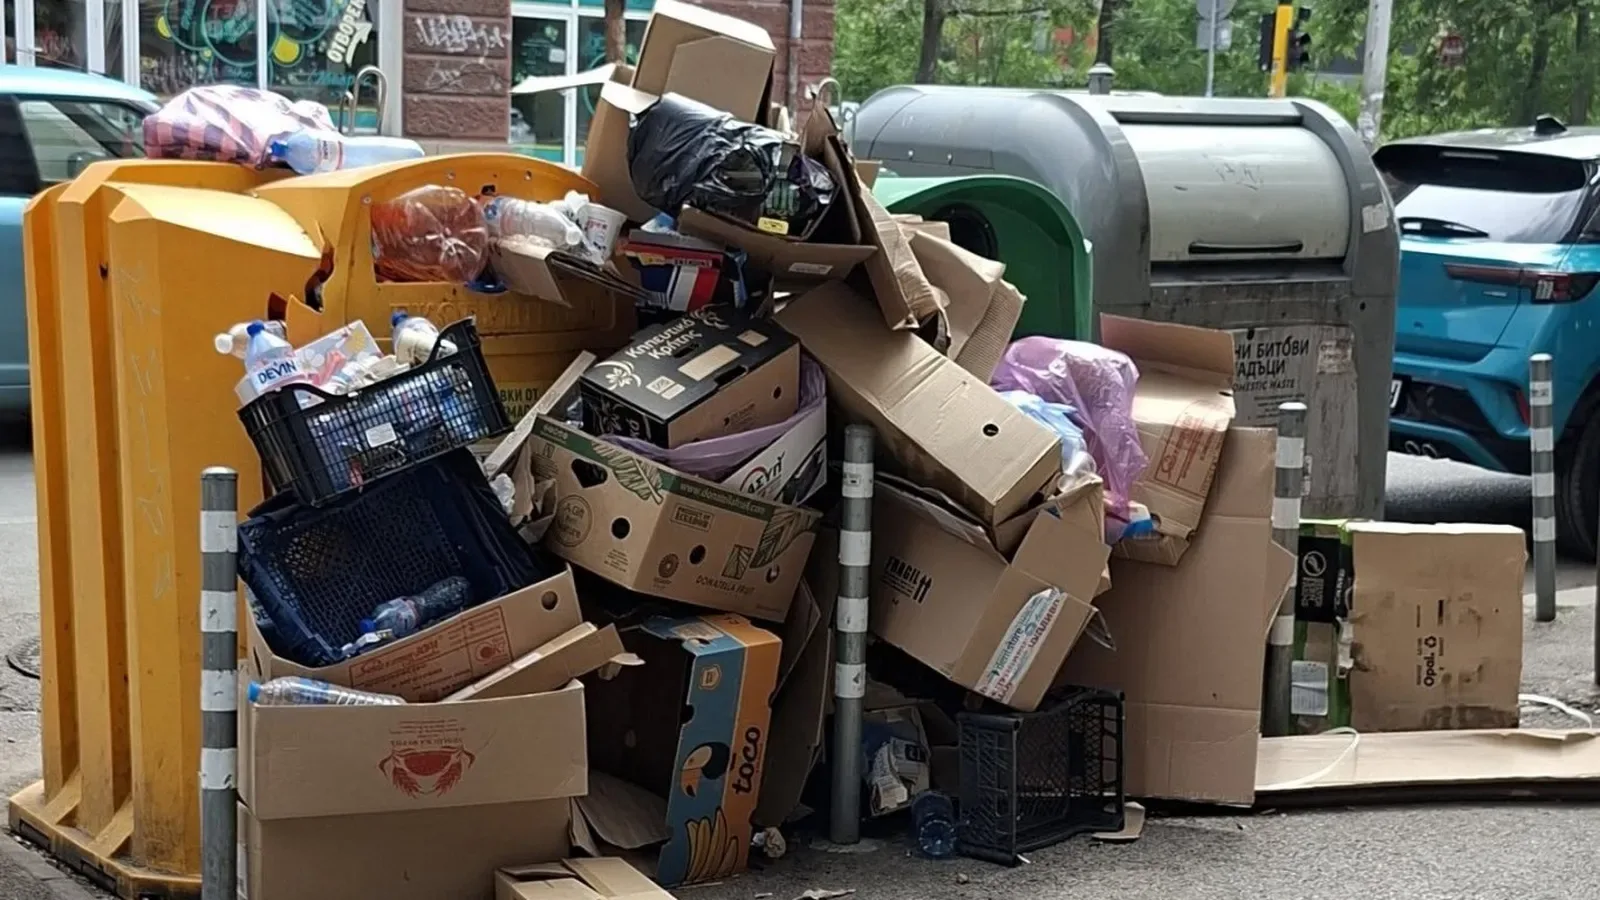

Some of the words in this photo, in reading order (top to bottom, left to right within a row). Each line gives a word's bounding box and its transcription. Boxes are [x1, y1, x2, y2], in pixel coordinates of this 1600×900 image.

[648, 330, 702, 360] Κρήτης
[1235, 343, 1251, 359] НИ
[258, 360, 297, 384] DEVIN
[1236, 360, 1285, 378] АДЪЦИ
[500, 388, 522, 401] ВКИ
[1232, 380, 1267, 392] OMESTIC
[1270, 379, 1295, 389] WASTE
[732, 727, 760, 795] toco
